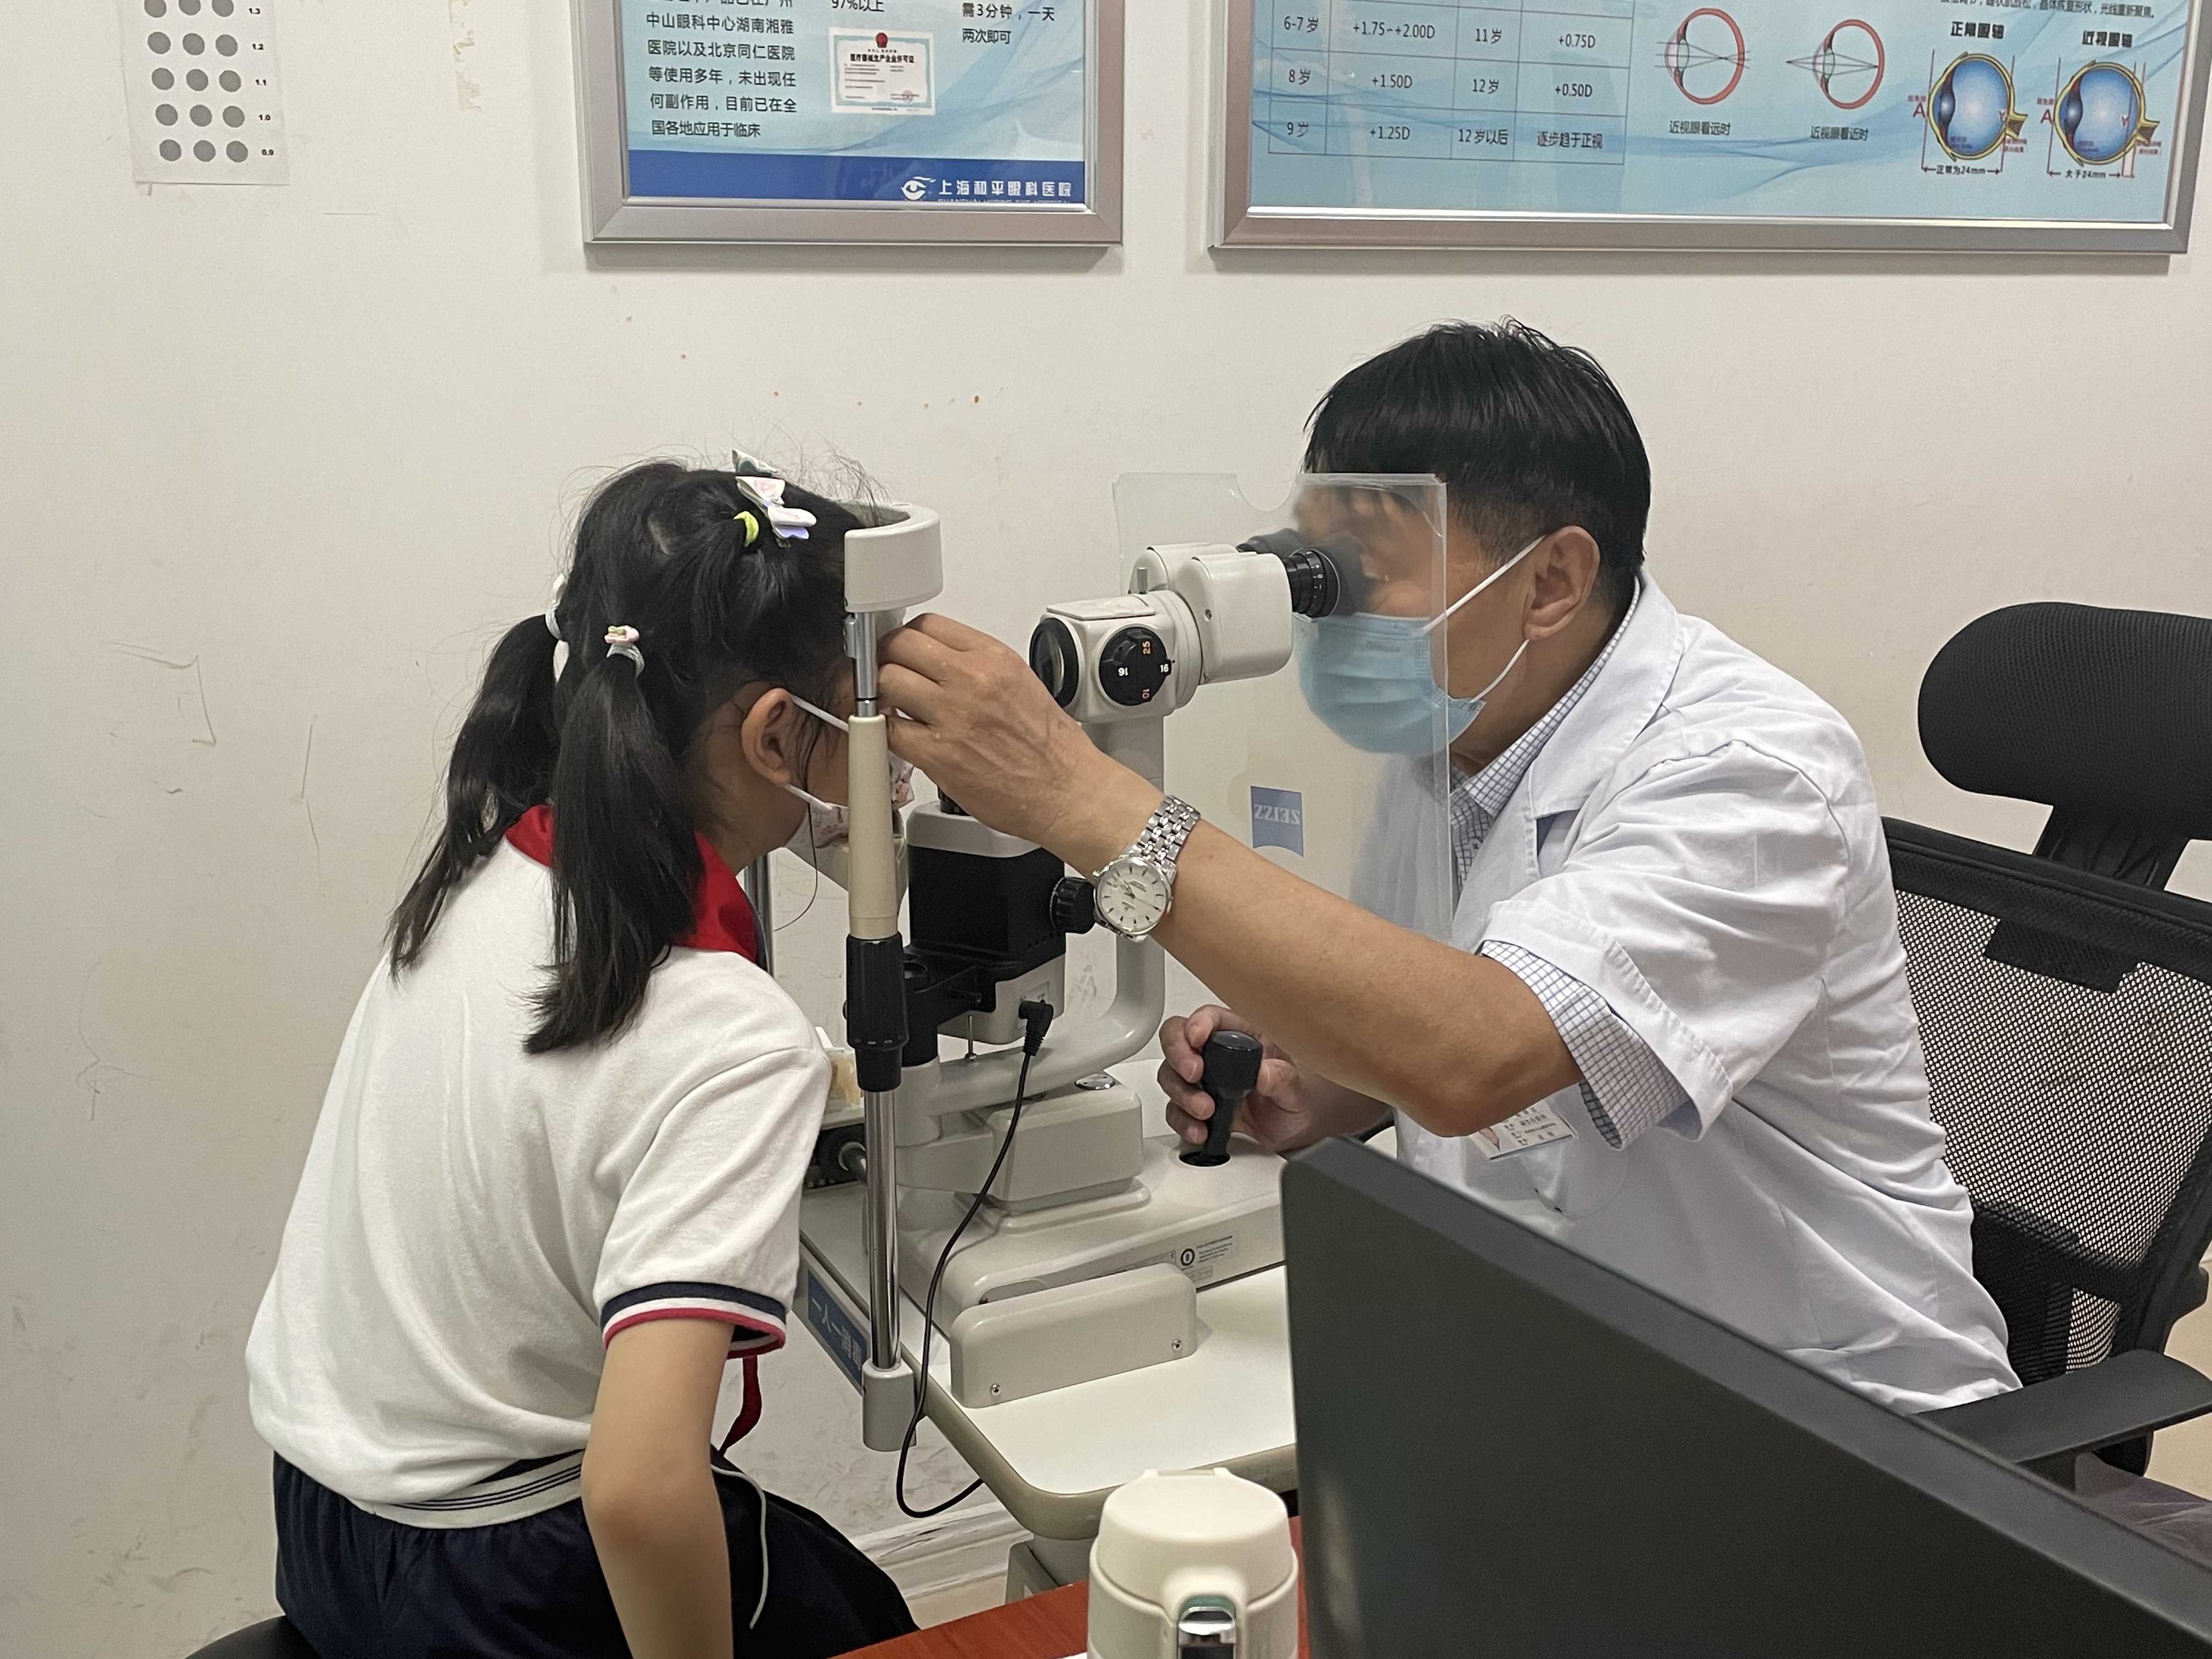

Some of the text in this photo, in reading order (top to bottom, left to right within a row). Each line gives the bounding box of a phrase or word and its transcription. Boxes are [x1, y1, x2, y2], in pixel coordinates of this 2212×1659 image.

[646, 11, 794, 35] 中山眼科中心湖南湘雅
[962, 28, 1011, 44] 两次即可
[1559, 33, 1596, 48] +0.75D
[647, 39, 795, 60] 医院以及北京同仁医院
[649, 66, 797, 87] 等使用多年，未出现任
[1372, 74, 1413, 88] +1.50D
[1555, 83, 1593, 97] +0.50D
[650, 93, 797, 113] 何副作用，目前已在全
[1912, 101, 1926, 118] A
[2040, 109, 2054, 125] A
[651, 120, 761, 138] 国各地应用于临床
[1370, 126, 1410, 140] +1.25D
[939, 179, 1071, 197] 上海和平眼科医院
[1142, 641, 1151, 654] 25
[1160, 663, 1169, 673] 16
